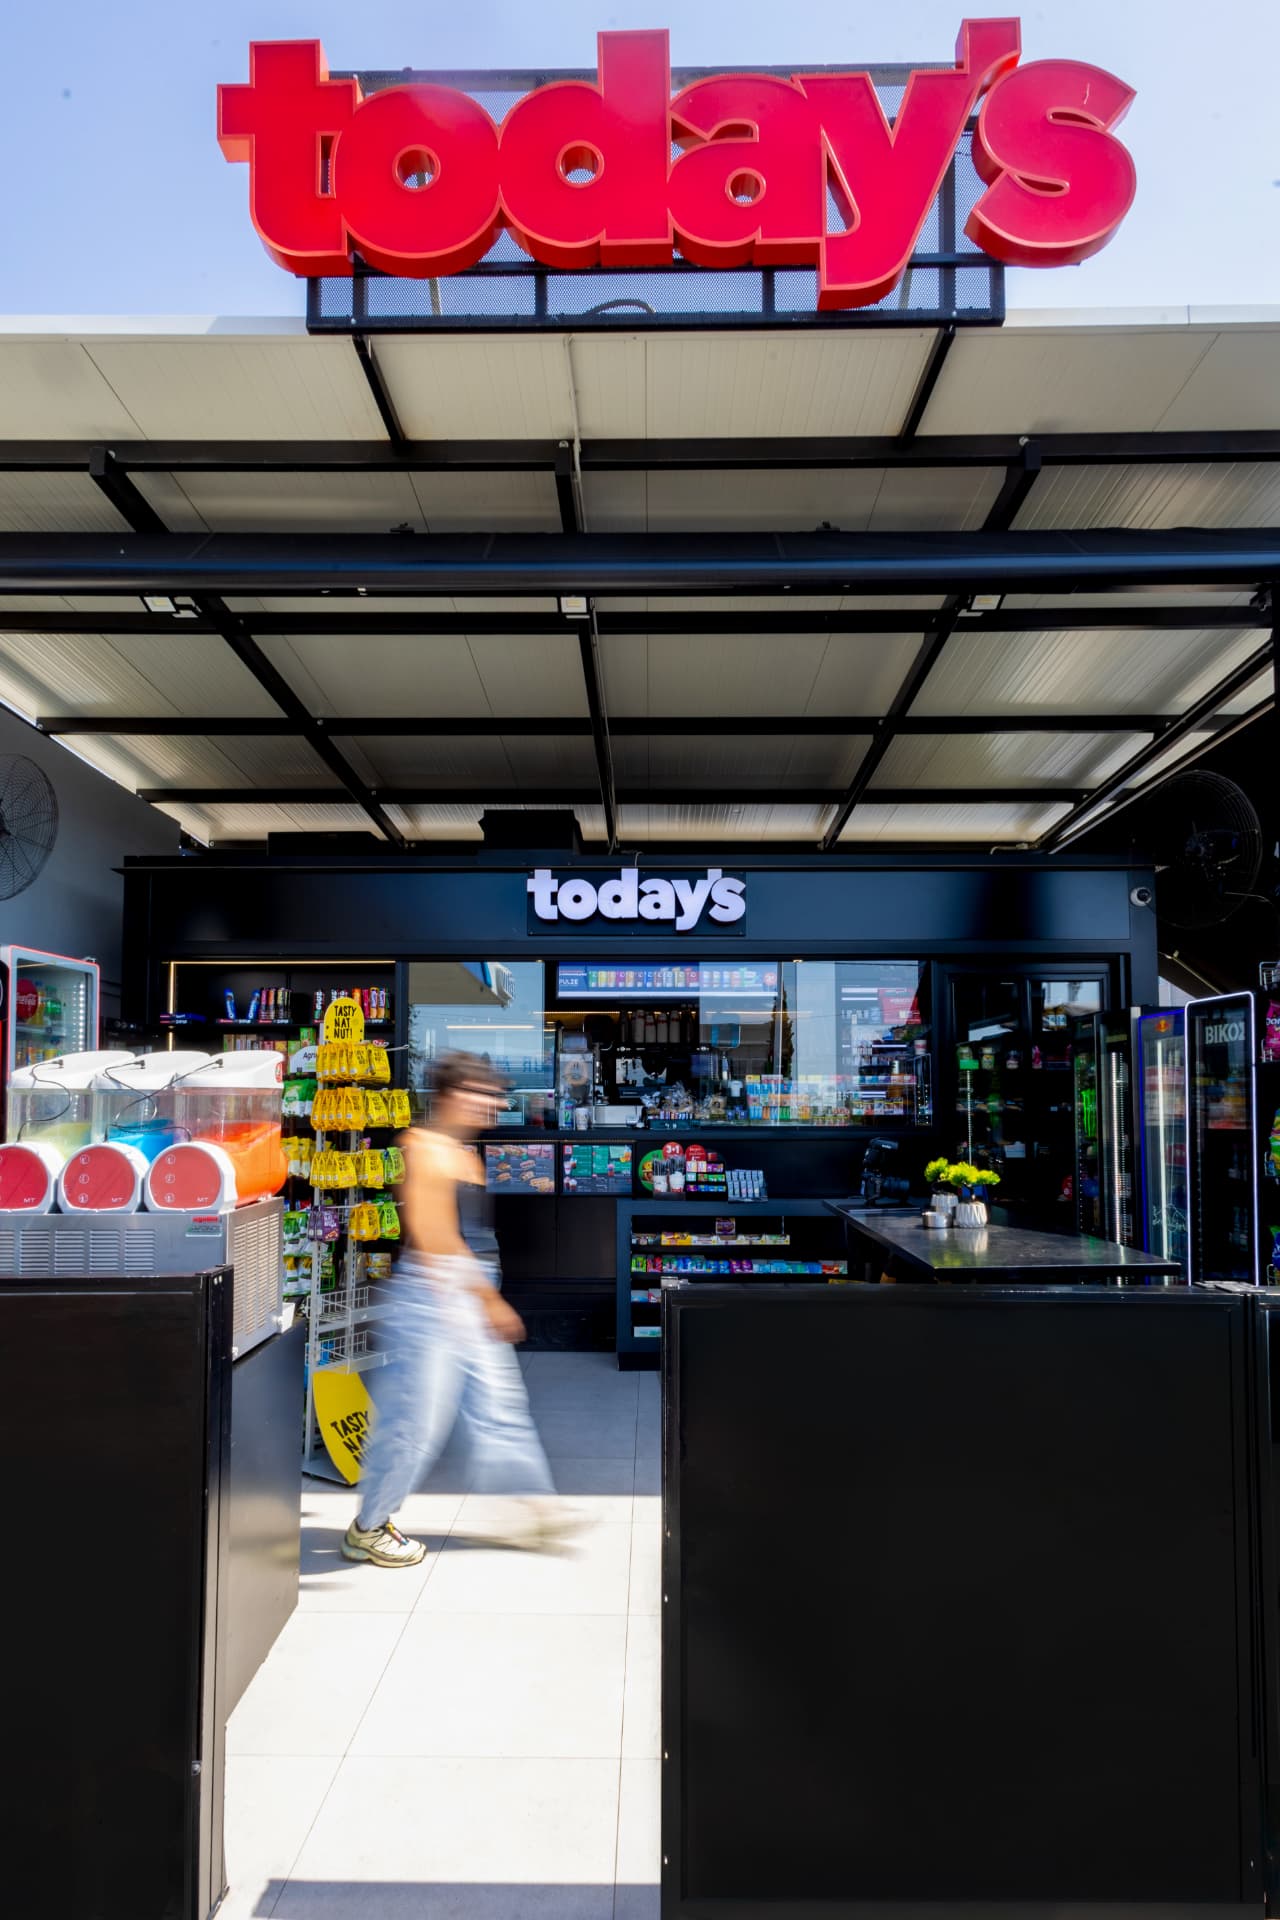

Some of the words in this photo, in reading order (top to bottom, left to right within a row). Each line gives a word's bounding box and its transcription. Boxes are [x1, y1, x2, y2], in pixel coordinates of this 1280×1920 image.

[217, 17, 1137, 310] today's
[527, 868, 747, 931] today's
[334, 1005, 357, 1017] TASTY
[334, 1017, 350, 1028] NAT
[333, 1028, 353, 1040] NUT!
[330, 1411, 371, 1439] TASTY
